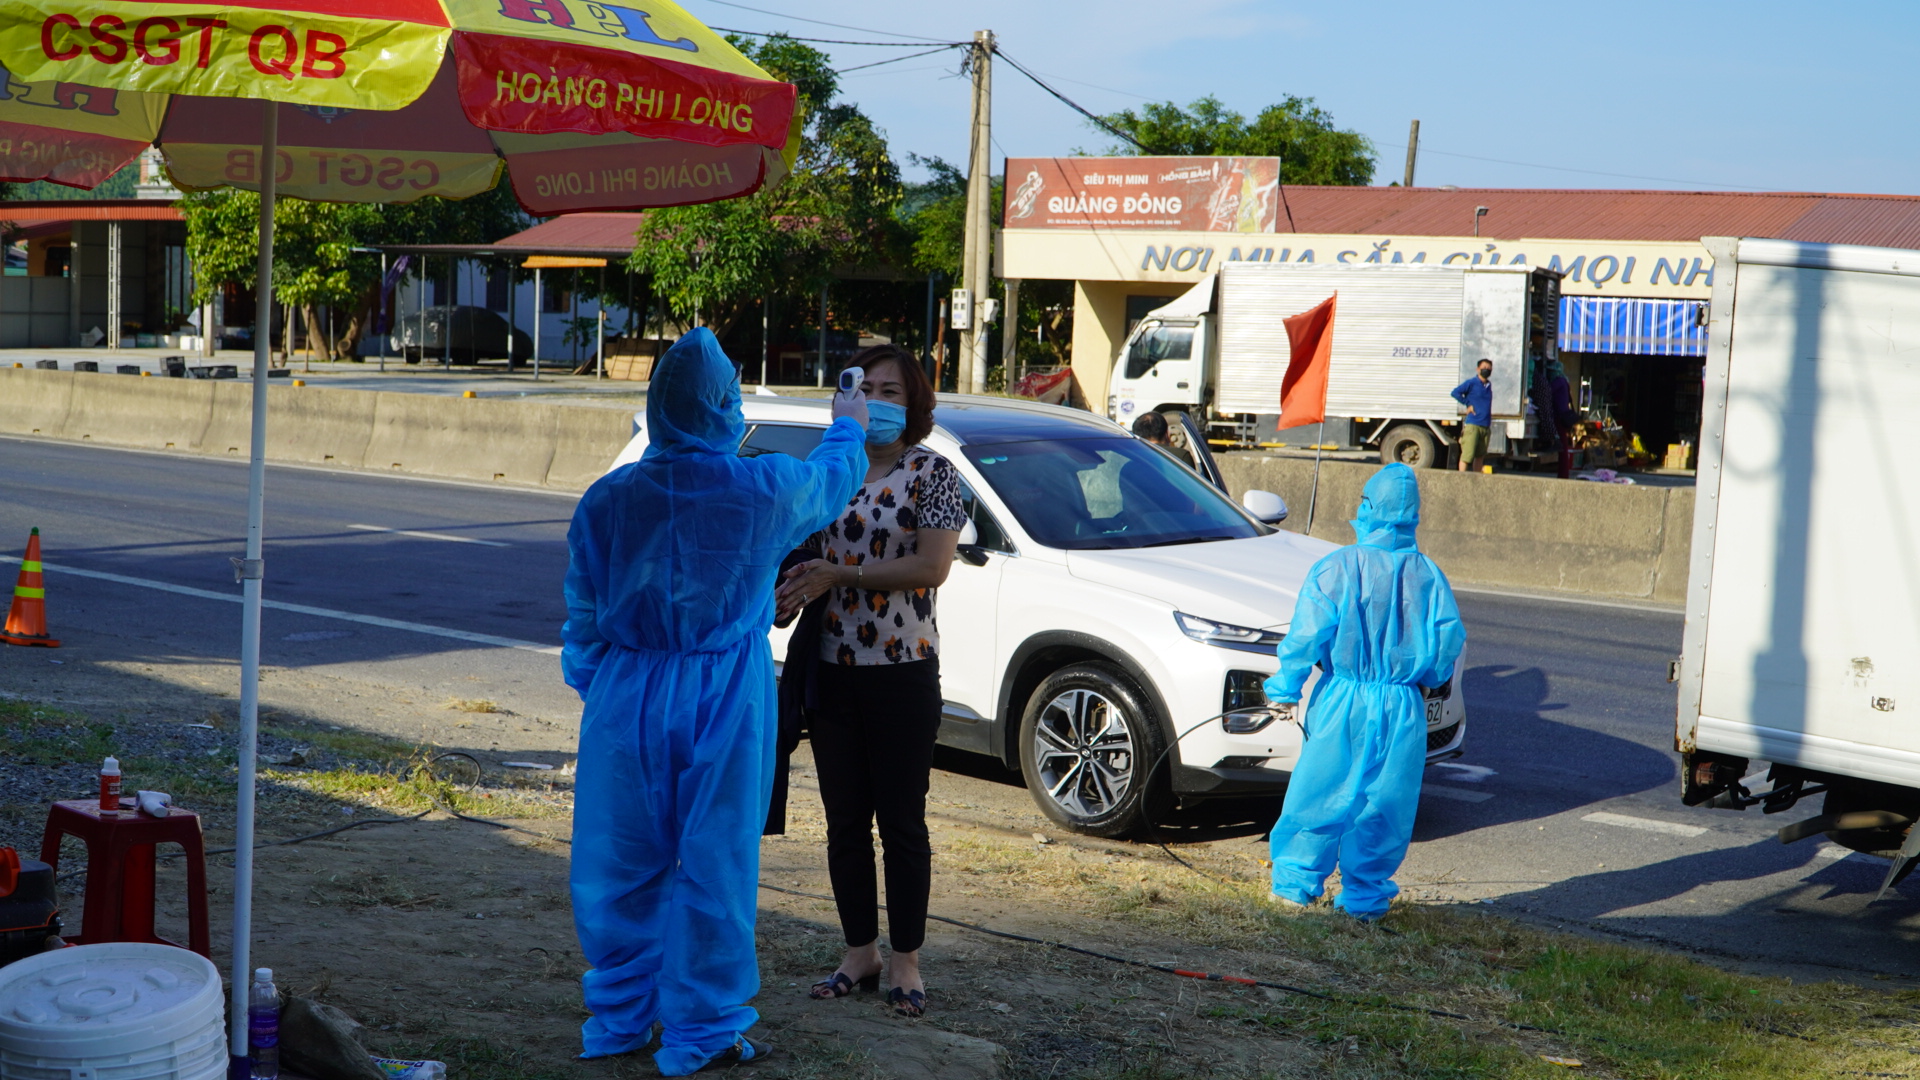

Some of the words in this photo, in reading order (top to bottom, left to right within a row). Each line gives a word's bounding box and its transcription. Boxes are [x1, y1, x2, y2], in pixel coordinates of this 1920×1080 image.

[41, 13, 228, 69] CSGT
[248, 24, 347, 81] QB
[496, 66, 607, 109] HOÀNG
[615, 83, 664, 119] PHI
[671, 93, 752, 133] LONG
[1083, 172, 1105, 185] SIÊU
[1107, 174, 1123, 188] THỊ
[1125, 174, 1149, 185] MINI
[1047, 190, 1118, 214] QUẢNG
[1122, 192, 1183, 214] ĐÔNG
[1141, 245, 1214, 272] NƠI
[1548, 254, 1636, 289] MỌI
[1650, 257, 1715, 287] NH
[1426, 701, 1441, 723] 62
